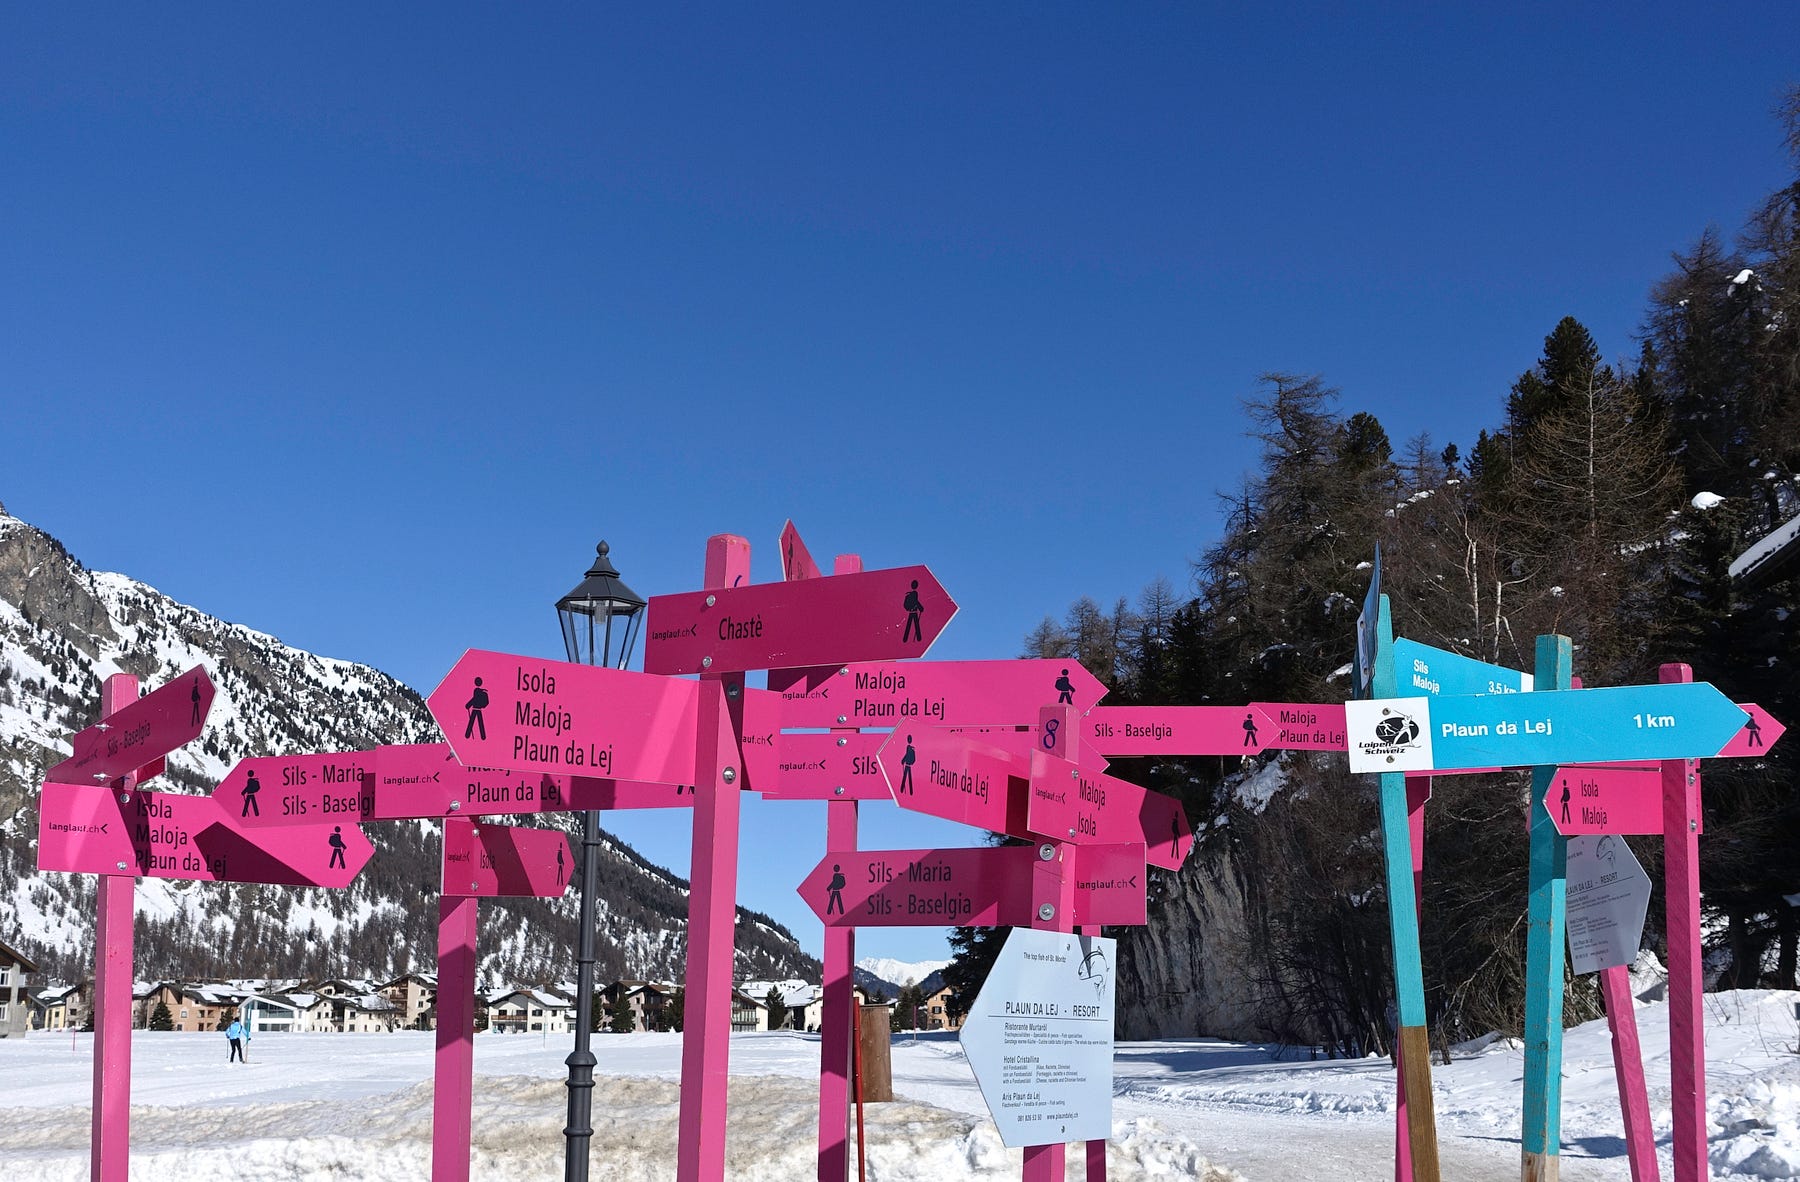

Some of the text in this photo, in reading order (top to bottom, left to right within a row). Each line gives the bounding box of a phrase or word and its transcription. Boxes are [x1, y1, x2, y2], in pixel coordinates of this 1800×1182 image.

[718, 614, 763, 640] Chastè
[1413, 658, 1429, 675] Sils
[517, 666, 556, 695] Isola
[855, 671, 906, 694] Maloja
[1412, 674, 1440, 696] Maloja
[1488, 680, 1502, 695] 3,5
[782, 690, 821, 701] nglauf.ch
[515, 701, 571, 737] Maloja
[854, 697, 945, 720] Plaun da Lej
[1280, 710, 1317, 727] Maloja
[1094, 723, 1113, 737] Sils
[1125, 722, 1172, 740] Baselgia
[1441, 718, 1553, 738] Plaun da Lej
[1633, 713, 1676, 728] 1 km
[107, 735, 118, 757] Sils
[124, 720, 151, 748] Baselgia
[1043, 718, 1060, 750] 8
[1280, 729, 1345, 747] Plaun da Lej
[513, 735, 613, 775] Plaun da Lej
[1359, 741, 1391, 749] Loipen
[1364, 747, 1406, 755] Schweiz
[282, 765, 307, 786] Sils
[322, 763, 365, 784] Maria
[779, 760, 818, 772] nglauf.ch
[852, 756, 878, 775] Sils
[383, 774, 432, 785] langlauf.ch
[930, 759, 989, 805] Plaun da Lej
[1580, 779, 1599, 798] Isola
[467, 779, 561, 805] Plaun da Lej
[1079, 778, 1106, 811] Maloja
[136, 800, 172, 819] Isola
[282, 795, 307, 815] Sils
[322, 792, 375, 816] Baselgi
[48, 822, 100, 834] langlauf.ch
[1077, 811, 1097, 836] Isola
[1582, 807, 1608, 829] Maloja
[135, 823, 188, 850] Maloja
[135, 850, 227, 877] Plaun da Lej
[480, 849, 496, 870] Isola
[868, 862, 893, 883] Sils
[908, 861, 952, 883] Maria
[1076, 879, 1128, 891] langlauf.ch
[867, 893, 892, 915] Sils
[908, 892, 972, 919] Baselgia
[1005, 1001, 1031, 1015] PLAUN
[1033, 1003, 1043, 1015] DA
[1046, 1003, 1059, 1016] LEJ
[1073, 1005, 1100, 1018] RESORT
[1003, 1056, 1016, 1064] Hotel
